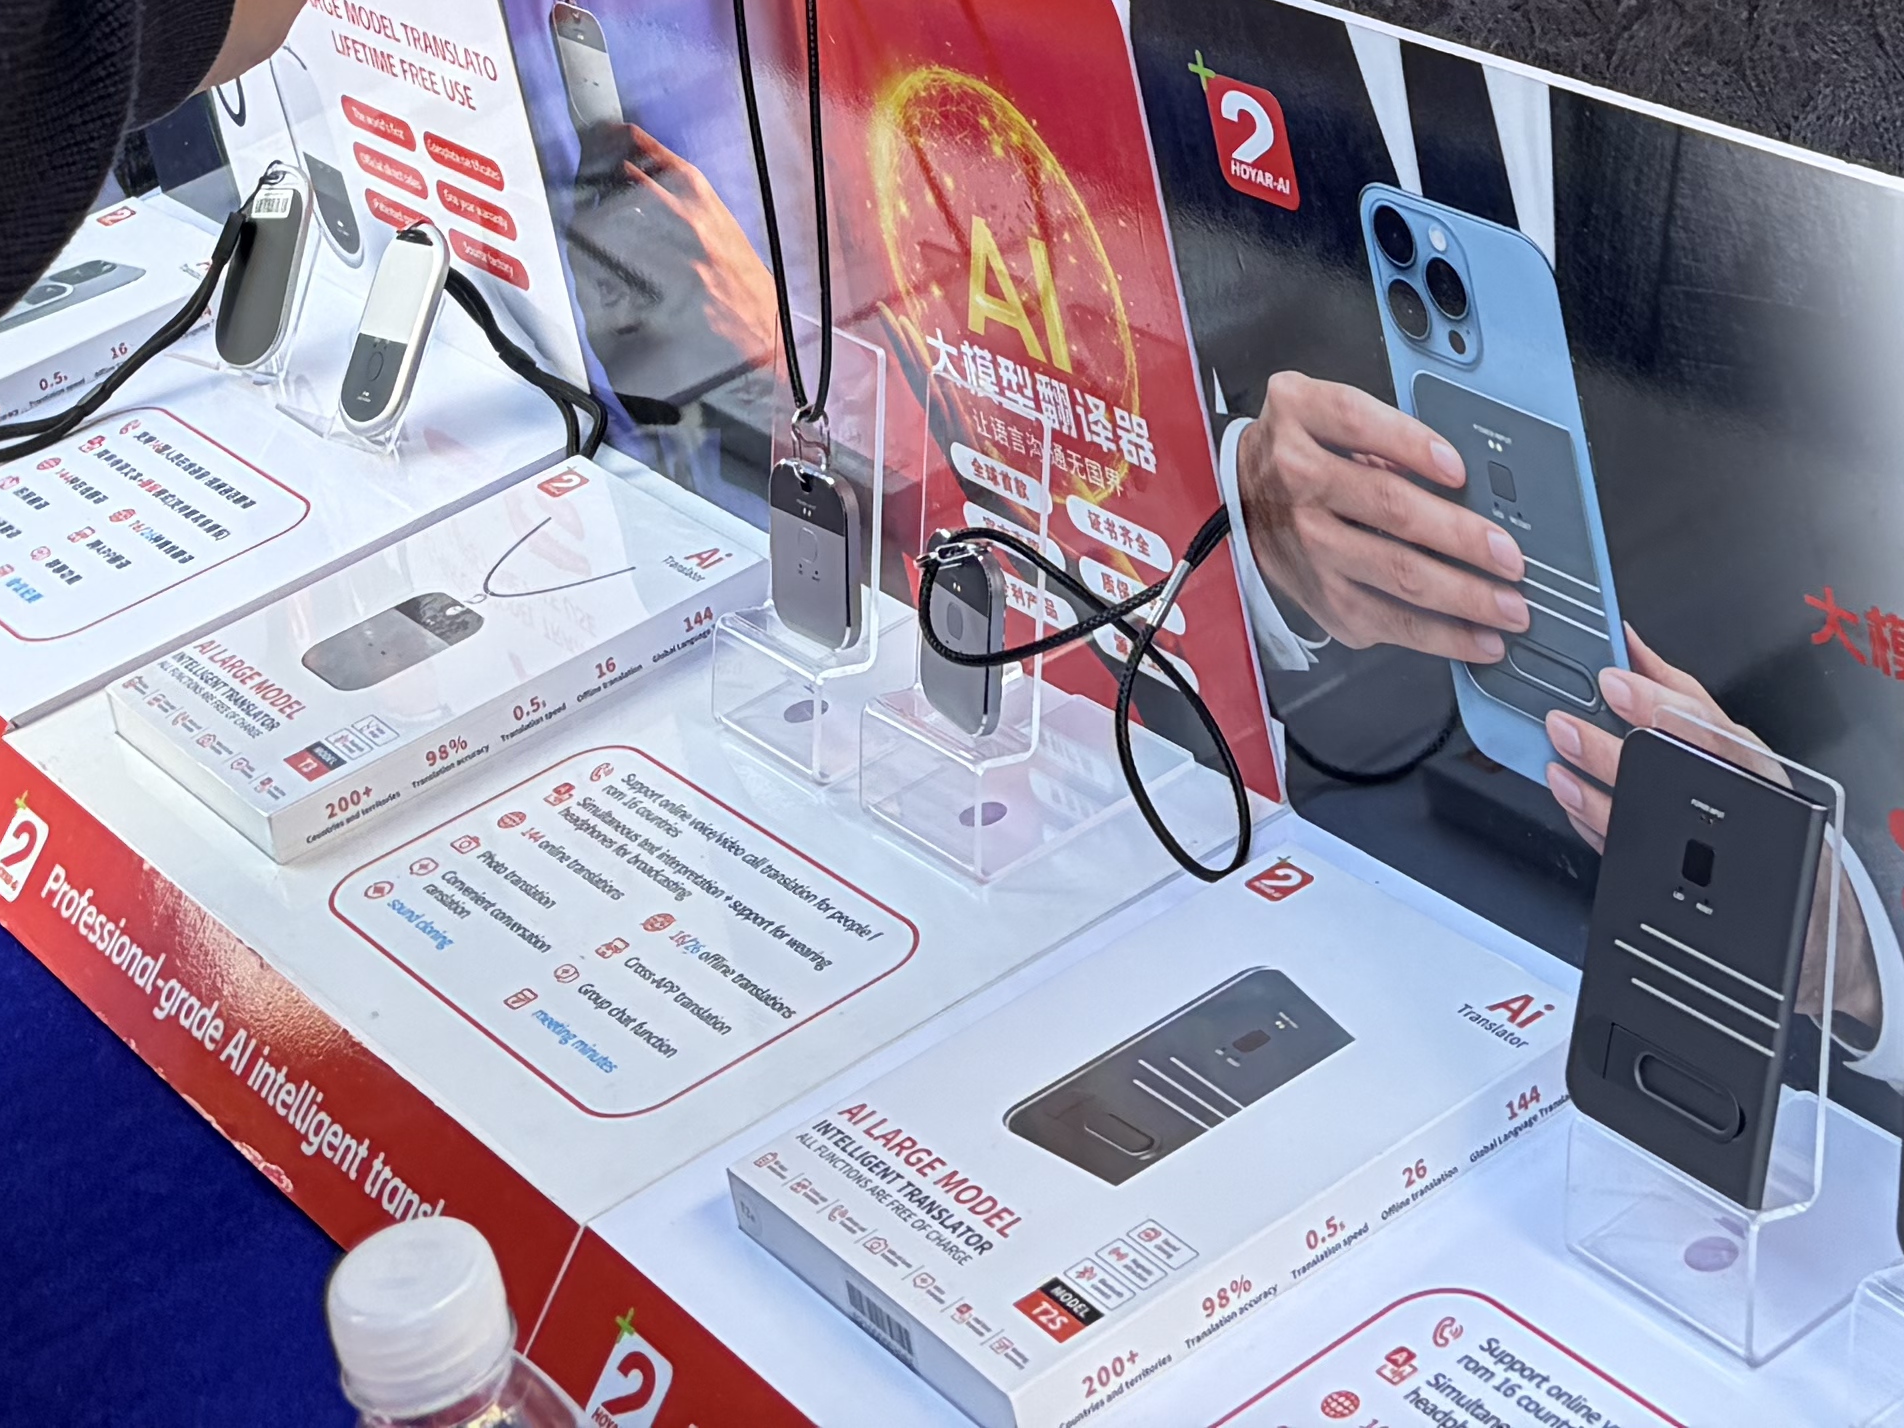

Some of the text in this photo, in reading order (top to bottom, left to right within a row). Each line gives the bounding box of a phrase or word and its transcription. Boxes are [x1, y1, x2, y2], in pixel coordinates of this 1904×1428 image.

[344, 0, 498, 82] MODEL TRANSLATO
[331, 29, 477, 112] LIFETIME FREE USE
[1220, 89, 1276, 163] 2
[1230, 159, 1292, 196] HOYAR-AI
[967, 214, 1073, 375] AI
[925, 327, 1158, 475] 大模型翻译器
[683, 546, 734, 571] Ai
[682, 606, 715, 634] 144
[193, 639, 222, 656] AI
[207, 648, 263, 686] LARGE
[594, 656, 617, 679] 16
[249, 678, 307, 721] MODEL
[424, 734, 470, 768] 98%
[324, 784, 375, 821] 200+
[0, 820, 38, 870] 2
[40, 863, 227, 1052] Professional-grade
[220, 1028, 250, 1076] AI
[247, 1053, 371, 1181] intelligent
[1457, 1003, 1530, 1052] Translator
[1485, 993, 1557, 1030] Ai
[1504, 1085, 1542, 1121] 144
[1468, 1113, 1540, 1165] Global Language
[812, 1117, 994, 1257] INTELLIGENT TRANSLATOR
[837, 1102, 1023, 1240] AI LARGE MODEL
[1380, 1165, 1460, 1222] Offline translation
[1401, 1159, 1428, 1189] 26
[796, 1131, 974, 1268] ALL FUNCTIONS ARE FREE OF CHARGE
[1289, 1222, 1370, 1282] Translation speed
[1029, 1299, 1072, 1332] T2S
[1050, 1283, 1092, 1321] MODEL
[1184, 1282, 1279, 1351] Translation accuracy
[1201, 1275, 1253, 1320] 98%
[601, 1350, 658, 1417] 2
[1080, 1348, 1141, 1400] 200+
[1105, 1381, 1125, 1407] and
[1124, 1353, 1173, 1392] territories
[1455, 1351, 1519, 1400] rom 16
[1477, 1336, 1602, 1428] Support online
